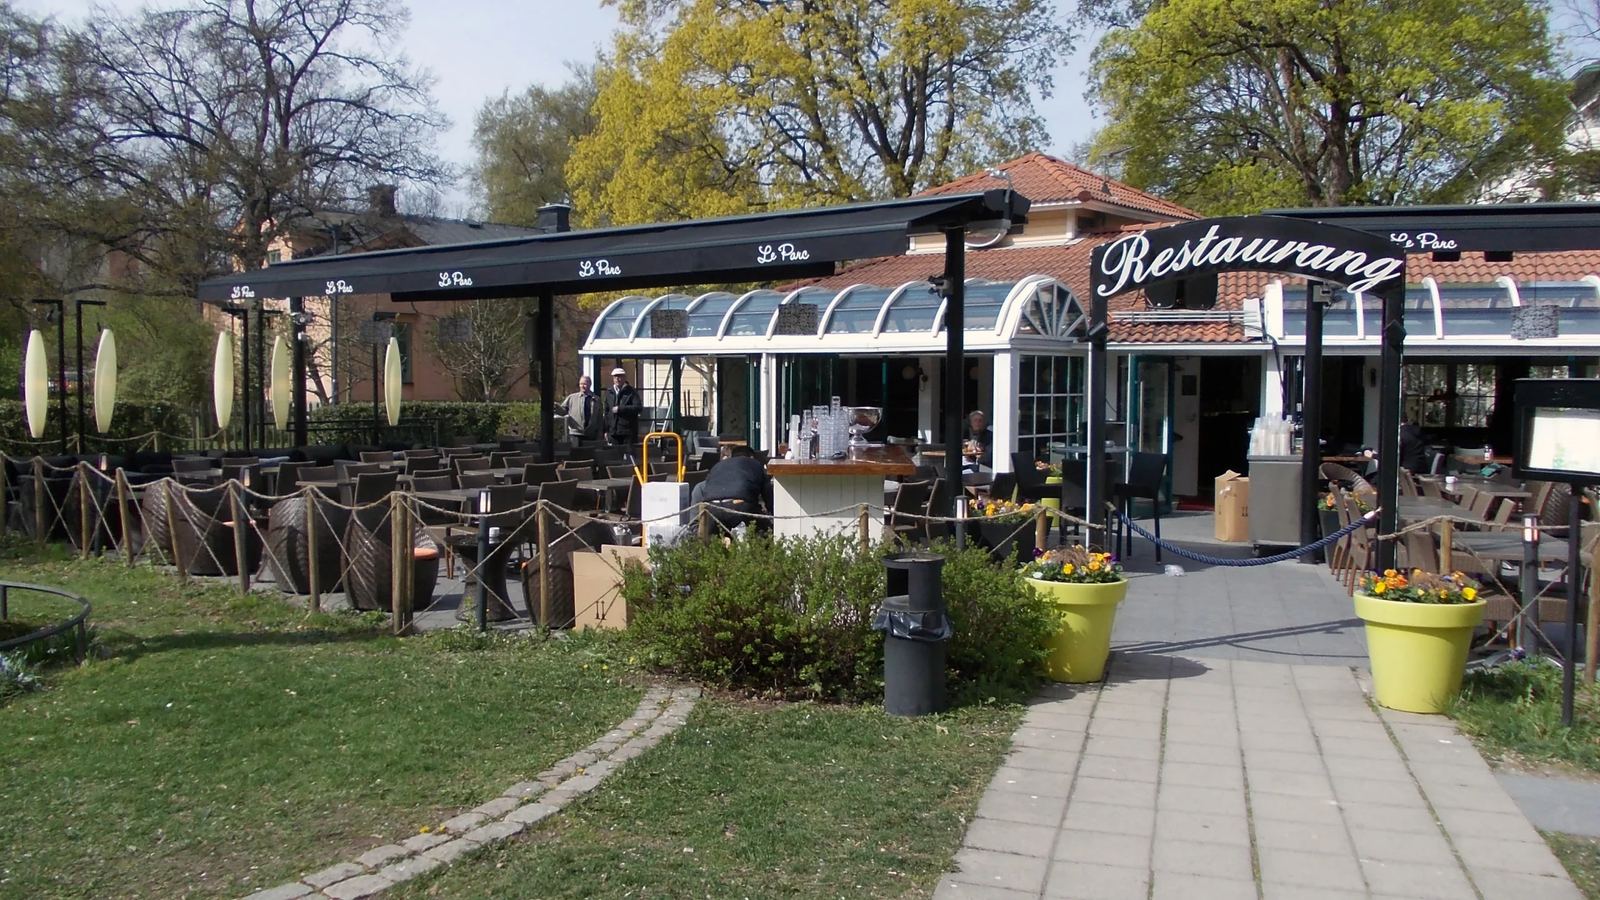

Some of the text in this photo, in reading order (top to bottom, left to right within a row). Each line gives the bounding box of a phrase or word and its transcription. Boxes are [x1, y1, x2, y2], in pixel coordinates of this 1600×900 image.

[1416, 232, 1458, 249] Parc
[757, 243, 810, 264] Le Parc
[1097, 224, 1402, 297] Restaurang
[579, 259, 621, 277] Le Parc
[438, 271, 473, 287] Le Parc
